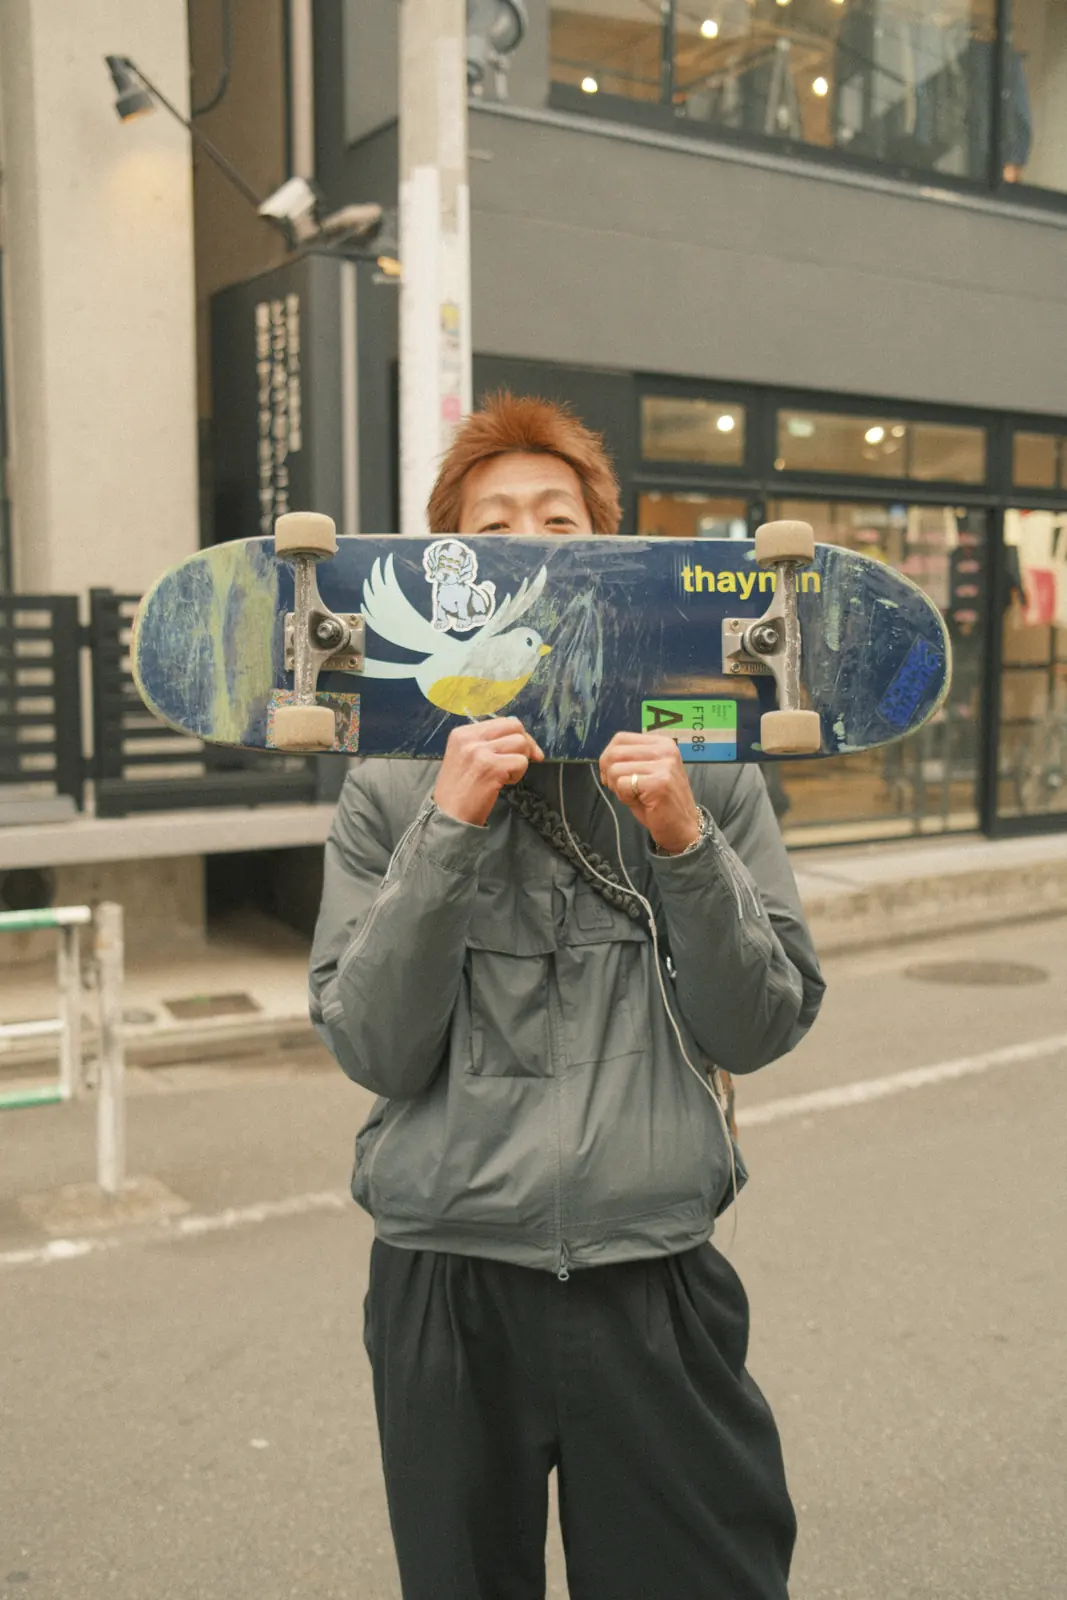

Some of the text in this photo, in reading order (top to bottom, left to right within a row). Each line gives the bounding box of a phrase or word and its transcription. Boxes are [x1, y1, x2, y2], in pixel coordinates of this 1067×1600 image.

[681, 564, 821, 600] thaynn
[691, 706, 705, 752] FTC 86
